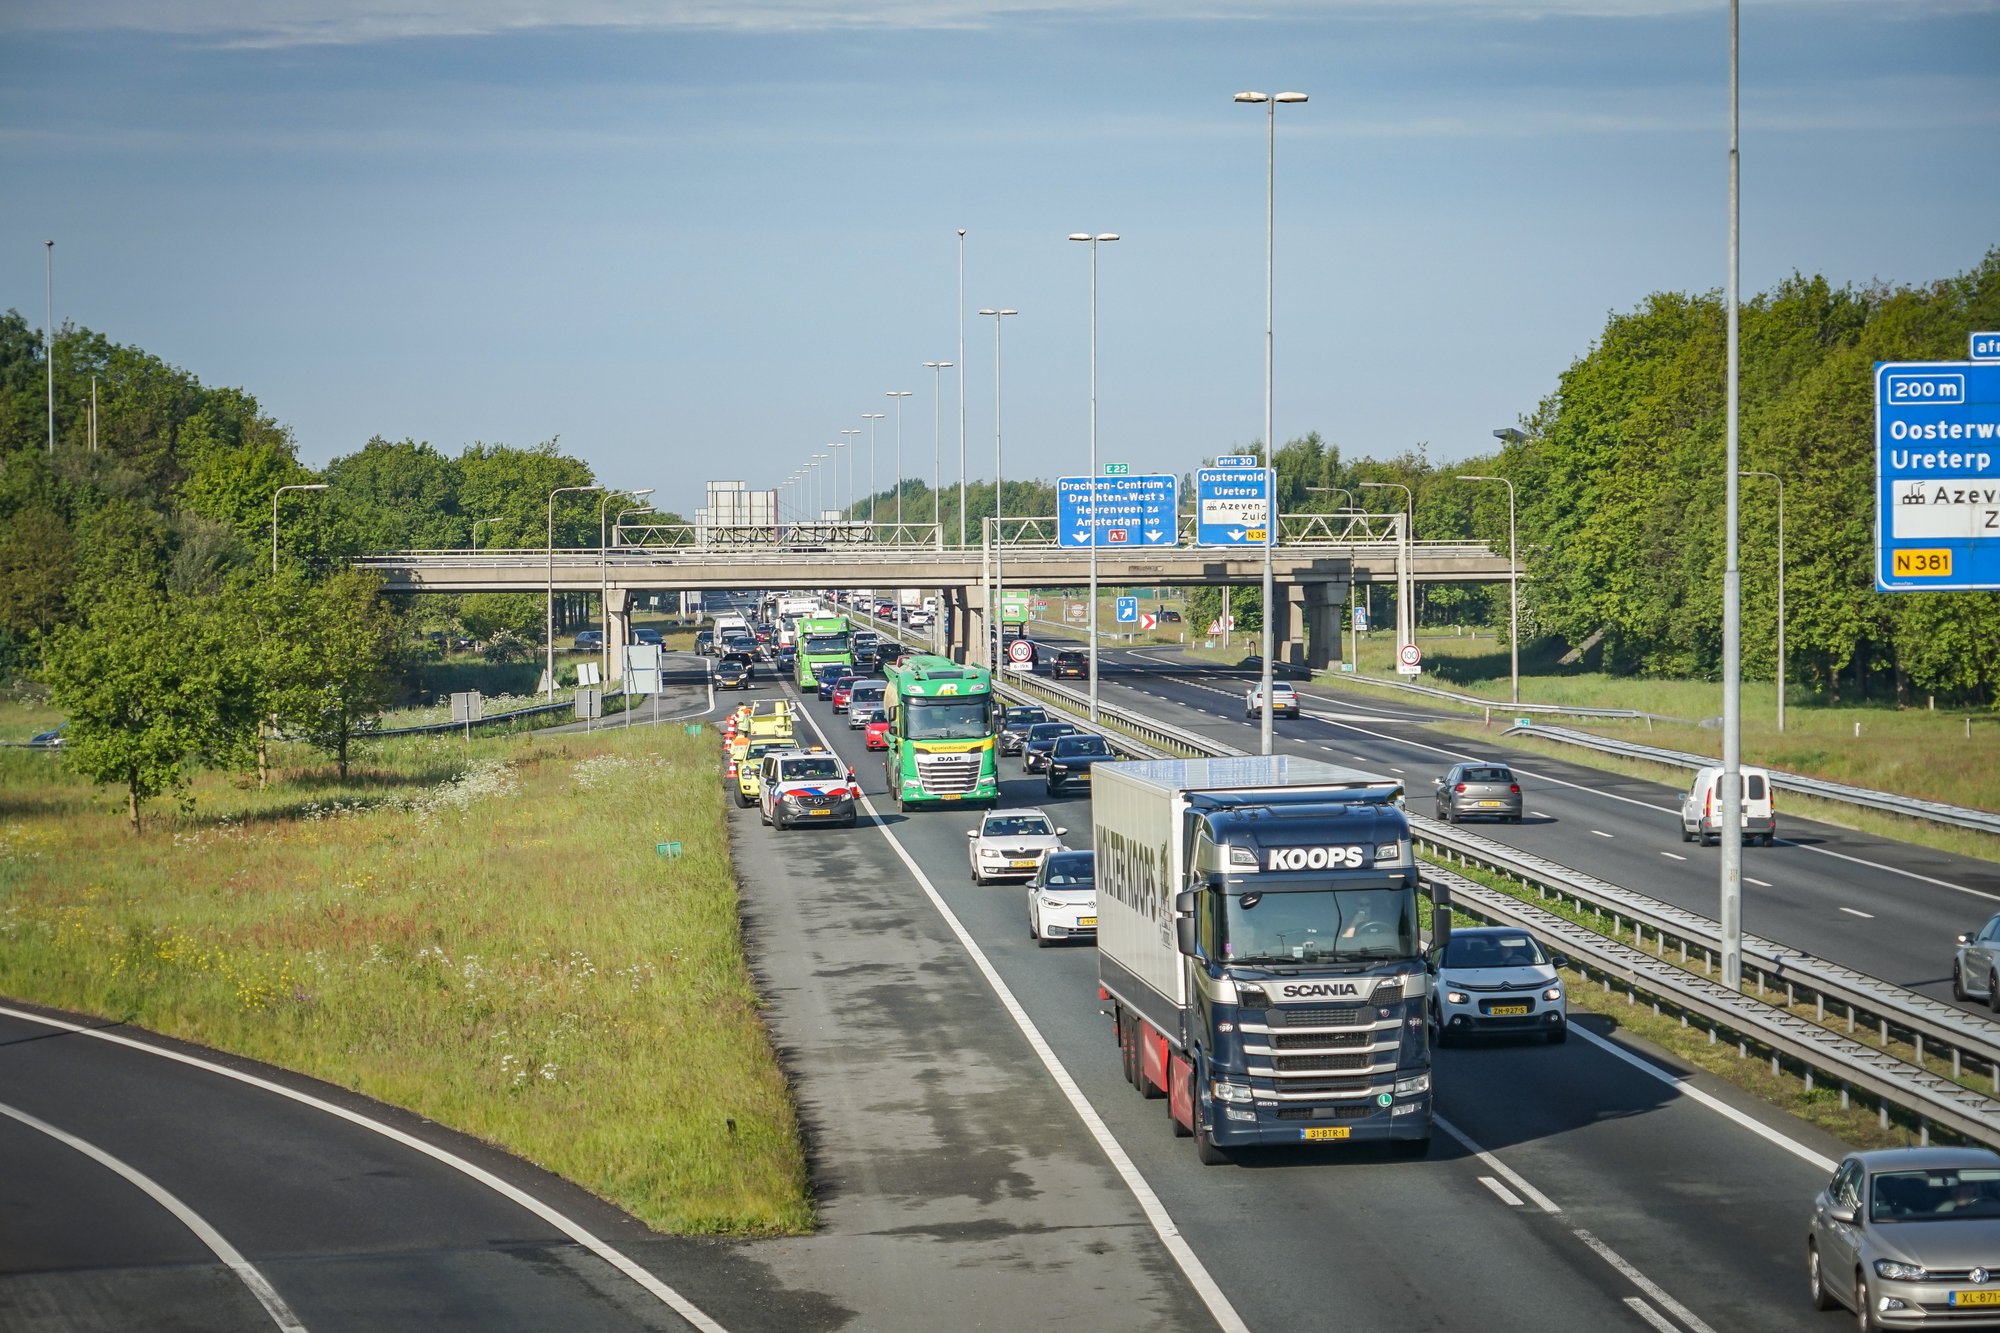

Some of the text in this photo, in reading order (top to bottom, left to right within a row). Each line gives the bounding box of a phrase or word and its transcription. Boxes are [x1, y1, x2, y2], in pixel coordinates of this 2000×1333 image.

[1895, 382, 1958, 398] 200 m
[1890, 420, 2000, 440] Oosterw
[1891, 450, 1991, 472] Ureterp
[1106, 465, 1127, 473] E22
[1202, 473, 1267, 482] Oosterwold
[1166, 481, 1173, 489] 4
[1214, 486, 1258, 496] Ureterp
[1933, 486, 2000, 504] Azev
[1220, 502, 1266, 510] Azeven-
[1241, 512, 1266, 520] Zuid
[1076, 517, 1160, 527] Amsterdam 149
[1111, 532, 1125, 540] A7
[1014, 647, 1028, 656] 100
[1404, 651, 1417, 660] 100
[1269, 846, 1364, 871] KOOPS
[1127, 837, 1157, 923] KOOPS
[1283, 983, 1359, 998] SCANIA
[1381, 1096, 1388, 1105] L
[1311, 1129, 1345, 1138] 31-BTR-1
